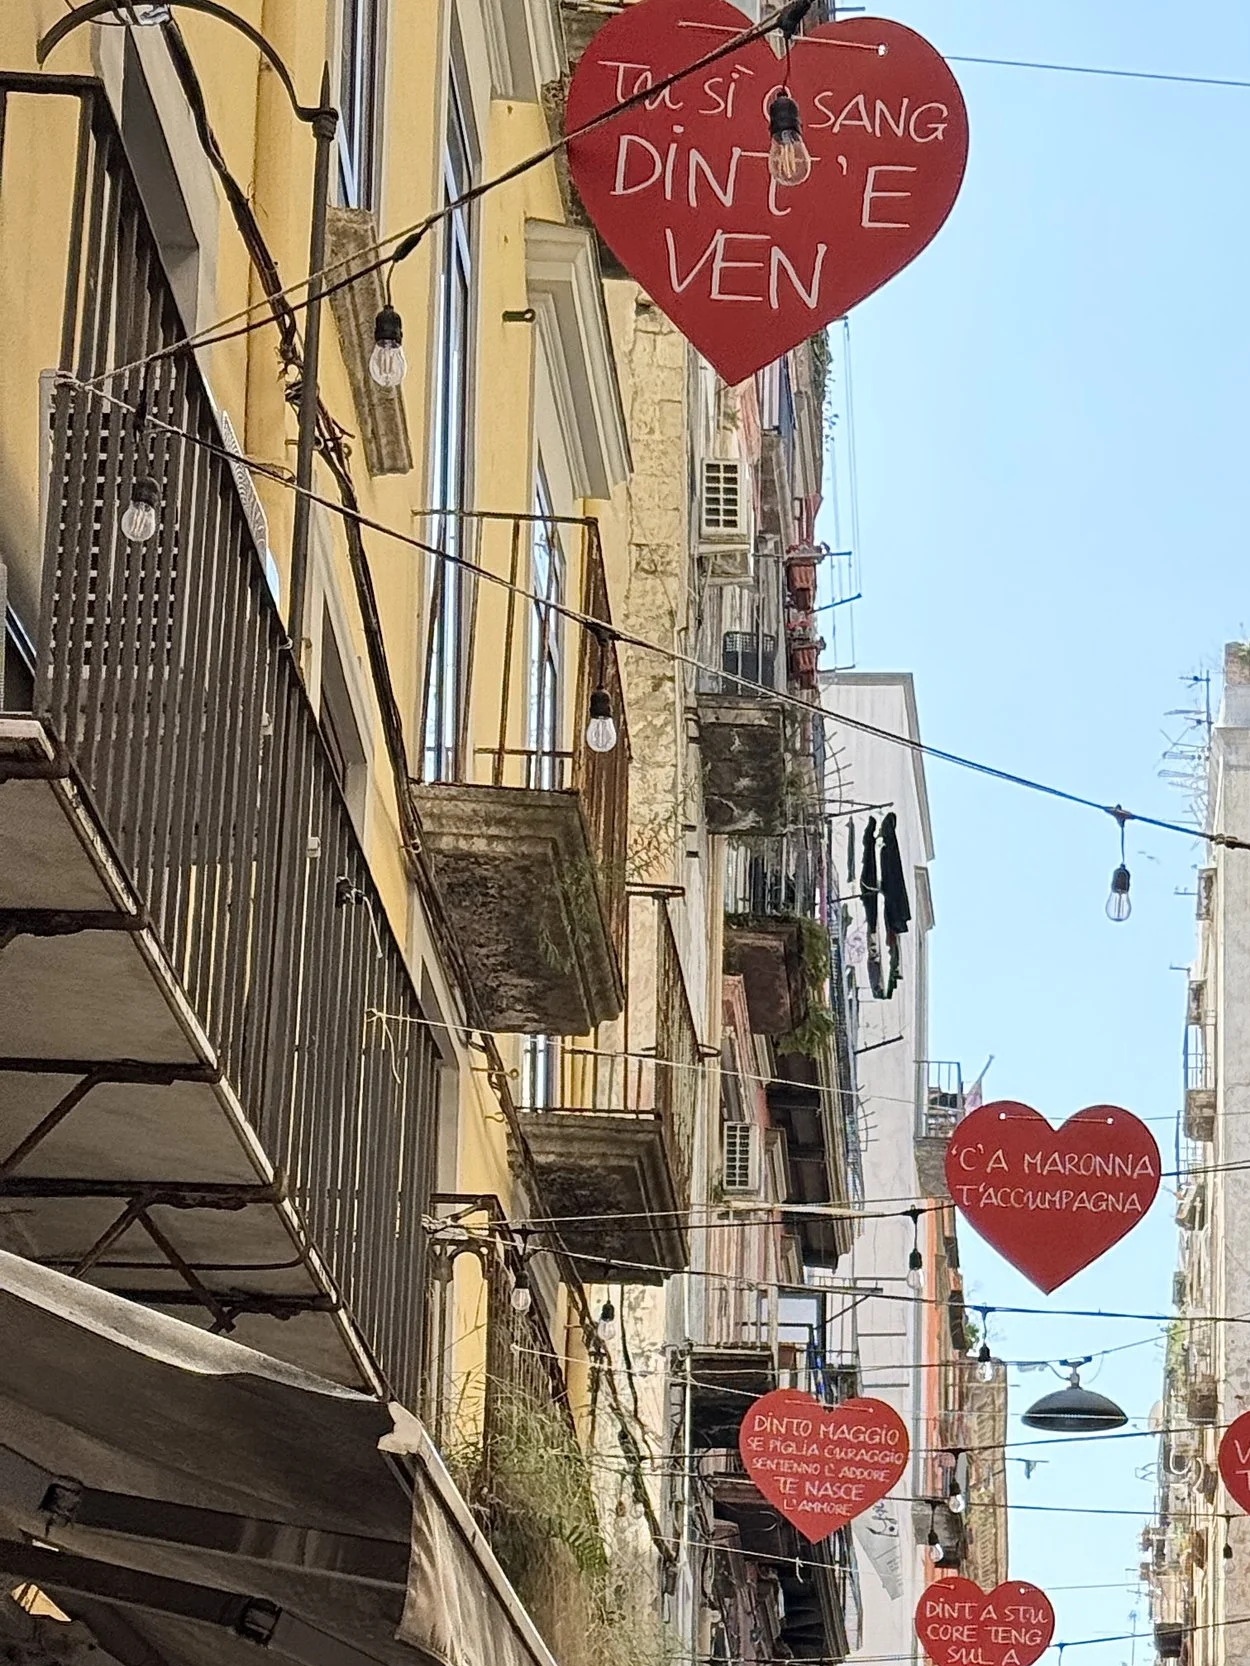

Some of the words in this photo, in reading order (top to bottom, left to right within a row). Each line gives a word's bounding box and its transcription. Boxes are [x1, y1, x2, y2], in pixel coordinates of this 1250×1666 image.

[808, 91, 948, 143] SANG
[665, 228, 827, 309] VEN
[1023, 1152, 1154, 1177] MARONNA
[956, 1182, 1142, 1213] T'ACCUMPAGNA
[748, 1436, 763, 1451] SE
[752, 1457, 820, 1475] SENTENNO
[774, 1476, 799, 1494] TE
[805, 1481, 865, 1501] NASCE
[980, 1605, 998, 1621] A
[1004, 1606, 1048, 1624] STU
[927, 1624, 978, 1642] CORE
[984, 1626, 1042, 1645] TENG
[1002, 1649, 1020, 1666] A
